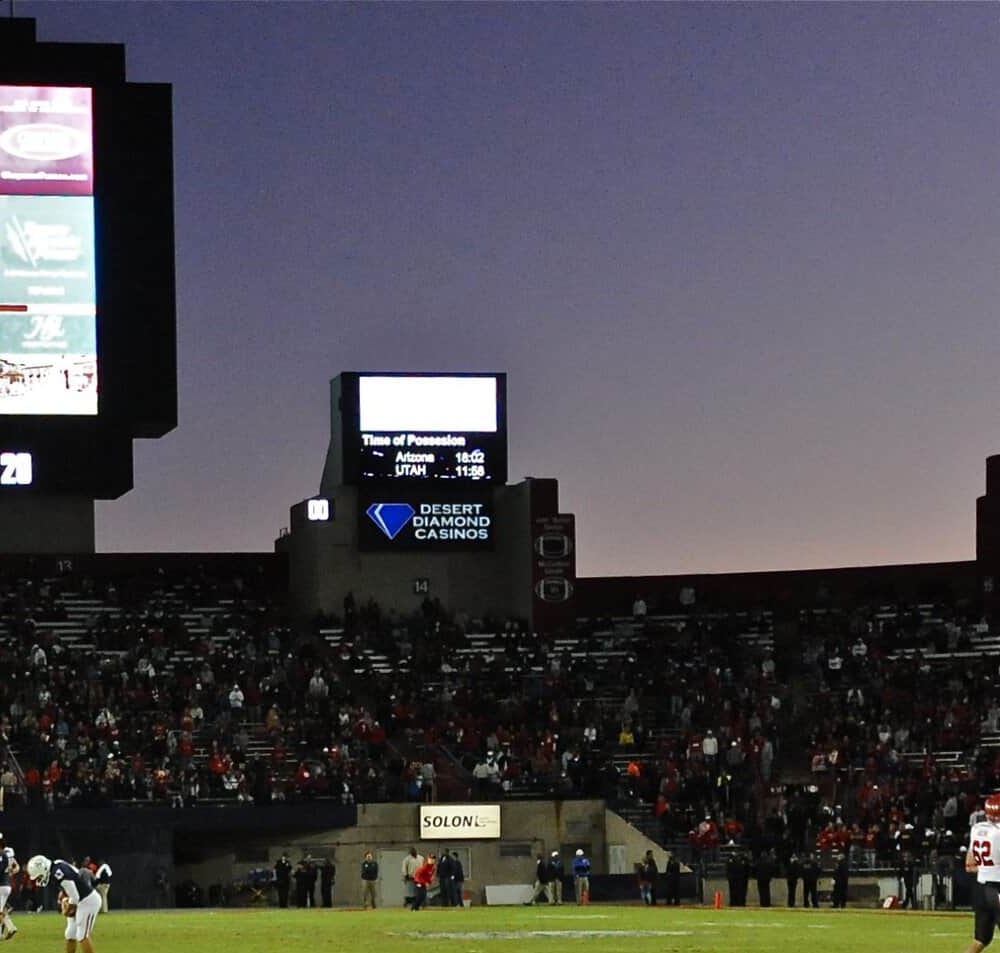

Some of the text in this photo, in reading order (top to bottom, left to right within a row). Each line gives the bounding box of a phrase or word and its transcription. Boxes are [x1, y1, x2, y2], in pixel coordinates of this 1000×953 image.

[362, 434, 391, 446] Time
[393, 434, 406, 446] of
[395, 452, 434, 463] Arizona
[395, 465, 426, 476] UTAH
[420, 504, 483, 515] DESERT
[413, 516, 490, 527] DIAMOND
[415, 529, 488, 540] CASINOS
[415, 581, 428, 592] 14
[423, 815, 473, 828] SOLON
